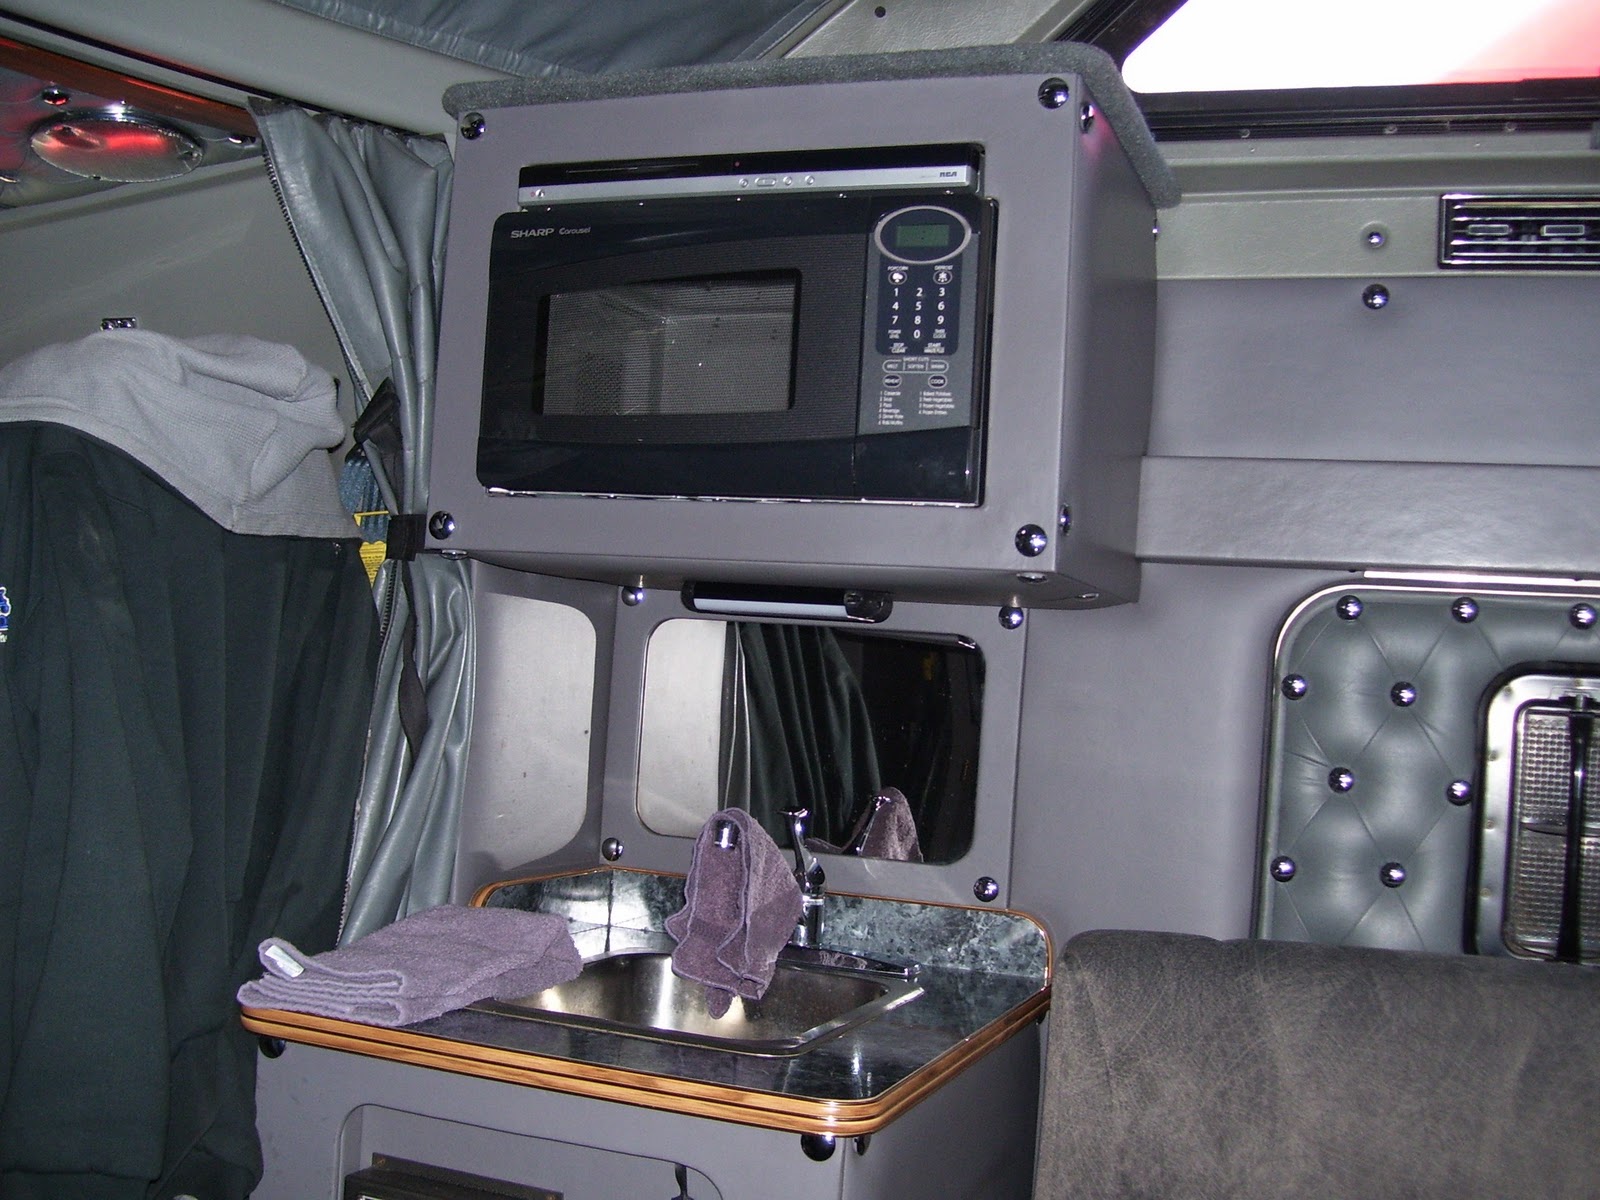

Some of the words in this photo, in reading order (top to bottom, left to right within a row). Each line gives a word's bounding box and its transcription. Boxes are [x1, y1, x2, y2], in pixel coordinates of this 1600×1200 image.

[510, 227, 555, 239] SHARP
[559, 226, 592, 235] Carousel
[894, 287, 899, 297] 1
[916, 287, 923, 297] 2
[938, 287, 946, 297] 3
[891, 301, 899, 311] 4
[915, 301, 922, 311] 5
[937, 301, 945, 311] 6
[891, 315, 899, 325] 7
[914, 315, 921, 325] 8
[937, 315, 945, 325] 9
[913, 329, 921, 339] 0
